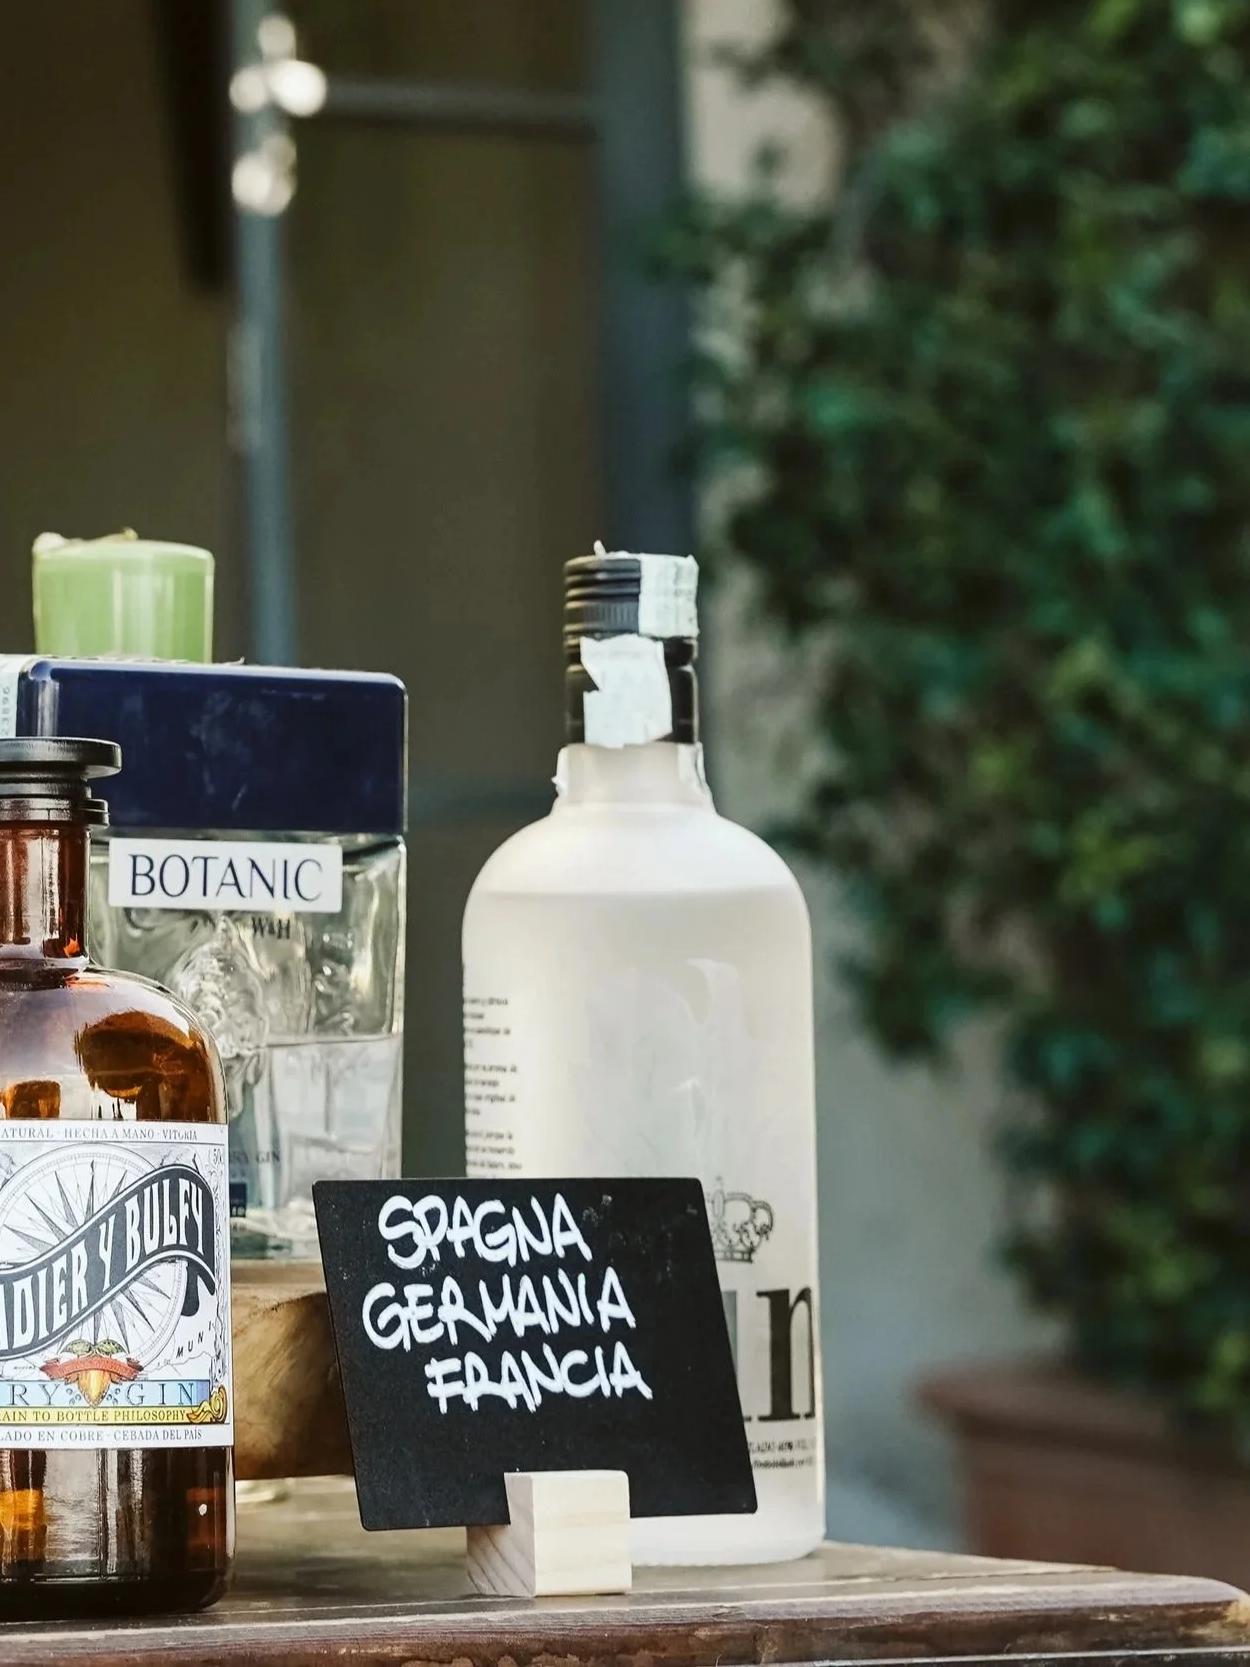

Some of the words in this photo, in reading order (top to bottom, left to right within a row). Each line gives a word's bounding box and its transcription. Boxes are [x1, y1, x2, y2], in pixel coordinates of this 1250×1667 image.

[128, 853, 324, 903] BOTANIC
[63, 1128, 109, 1140] HECHA
[122, 1129, 155, 1140] MANO
[99, 1215, 117, 1292] Y
[124, 1178, 205, 1274] BULFY
[378, 1192, 594, 1270] SPAGNA
[362, 1266, 636, 1352] GERMANIA
[125, 1383, 198, 1407] GIN
[424, 1341, 653, 1415] FRANCIA
[33, 1410, 50, 1422] TO
[56, 1410, 109, 1422] BOTTLE
[113, 1409, 187, 1422] PHILOSOPHY
[37, 1430, 55, 1442] EN
[60, 1430, 105, 1442] COBRE
[113, 1429, 160, 1441] CEBADA
[162, 1429, 182, 1441] DEL
[183, 1427, 203, 1441] PAÍS
